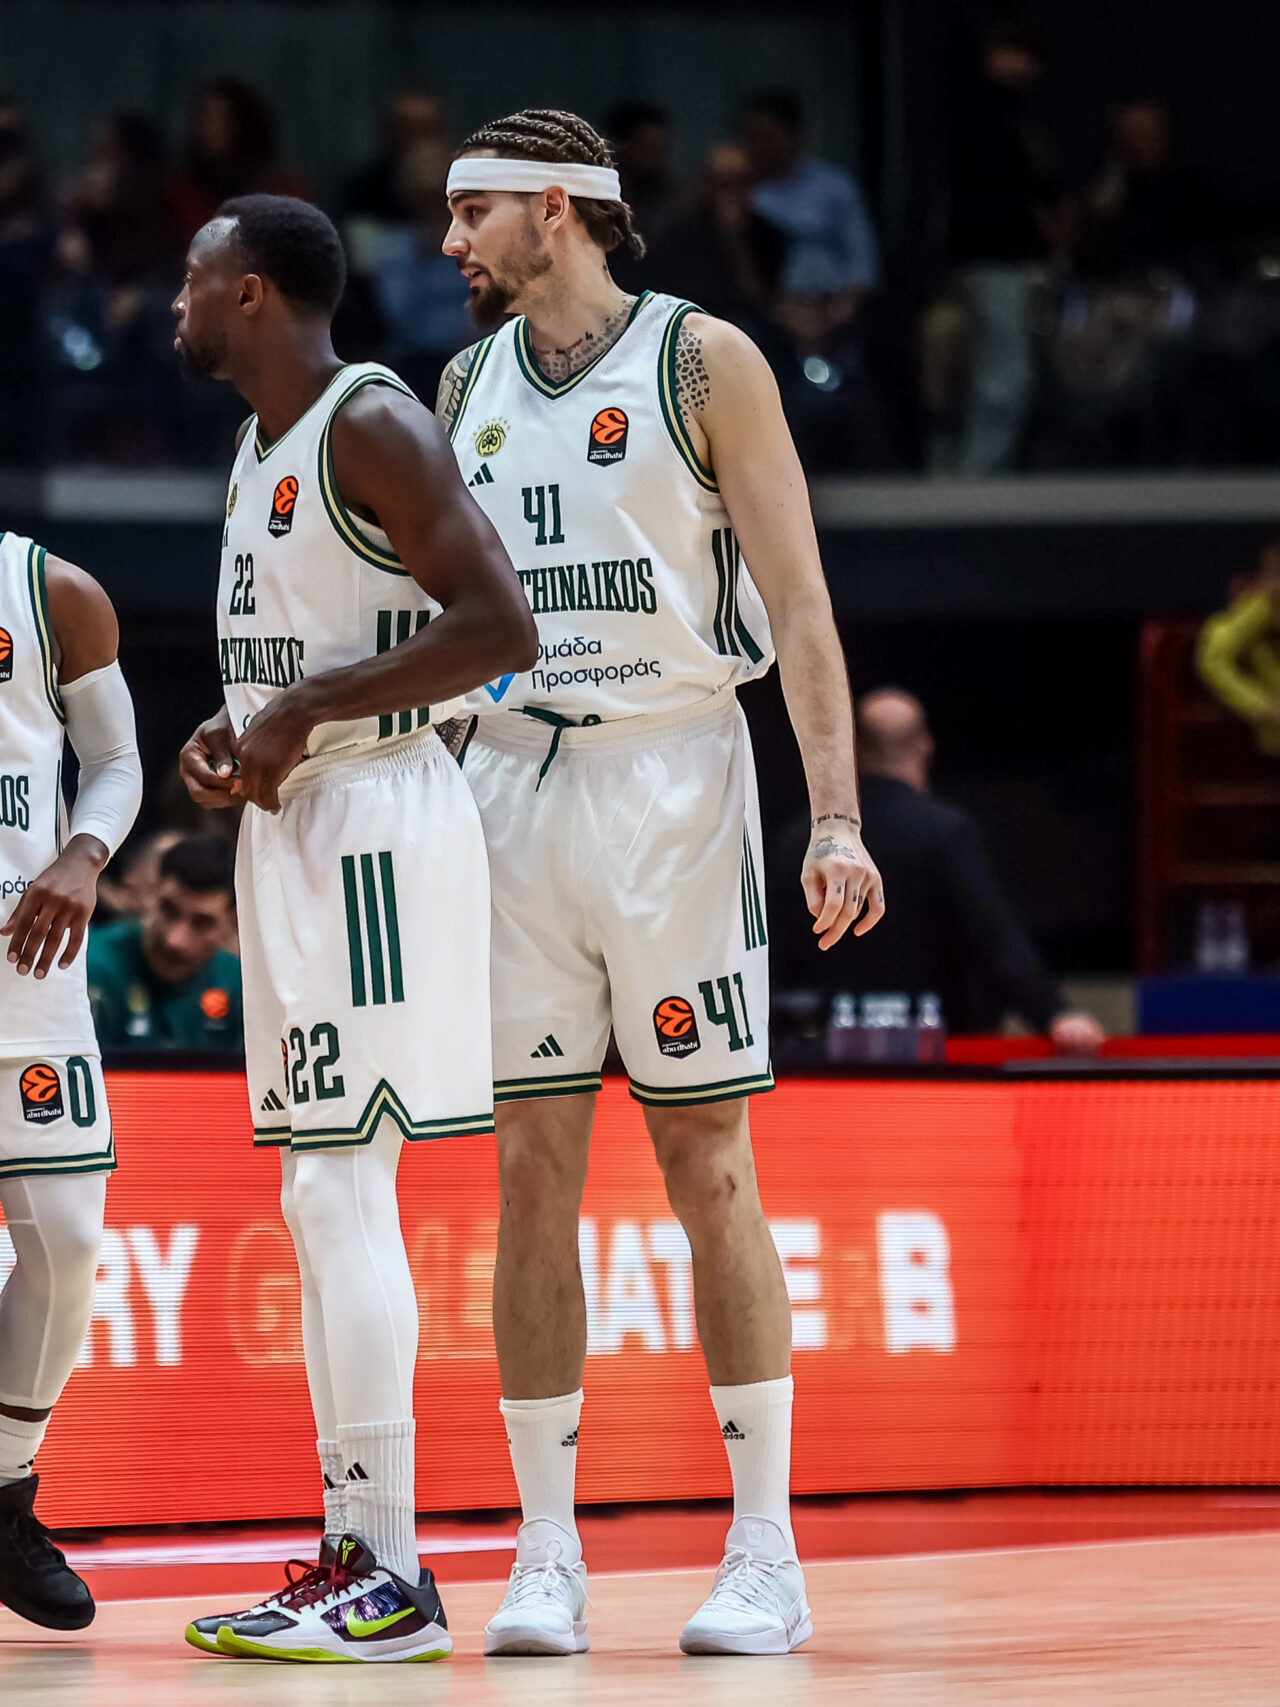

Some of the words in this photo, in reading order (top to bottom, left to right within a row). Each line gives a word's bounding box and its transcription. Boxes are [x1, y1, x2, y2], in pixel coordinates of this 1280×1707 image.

[521, 484, 565, 545] 41
[229, 553, 255, 615] 22
[516, 557, 657, 615] THINAIKOS
[532, 657, 662, 693] Προσφοράς
[697, 972, 754, 1052] 41
[66, 1056, 97, 1128] 0
[289, 1022, 346, 1105] 22
